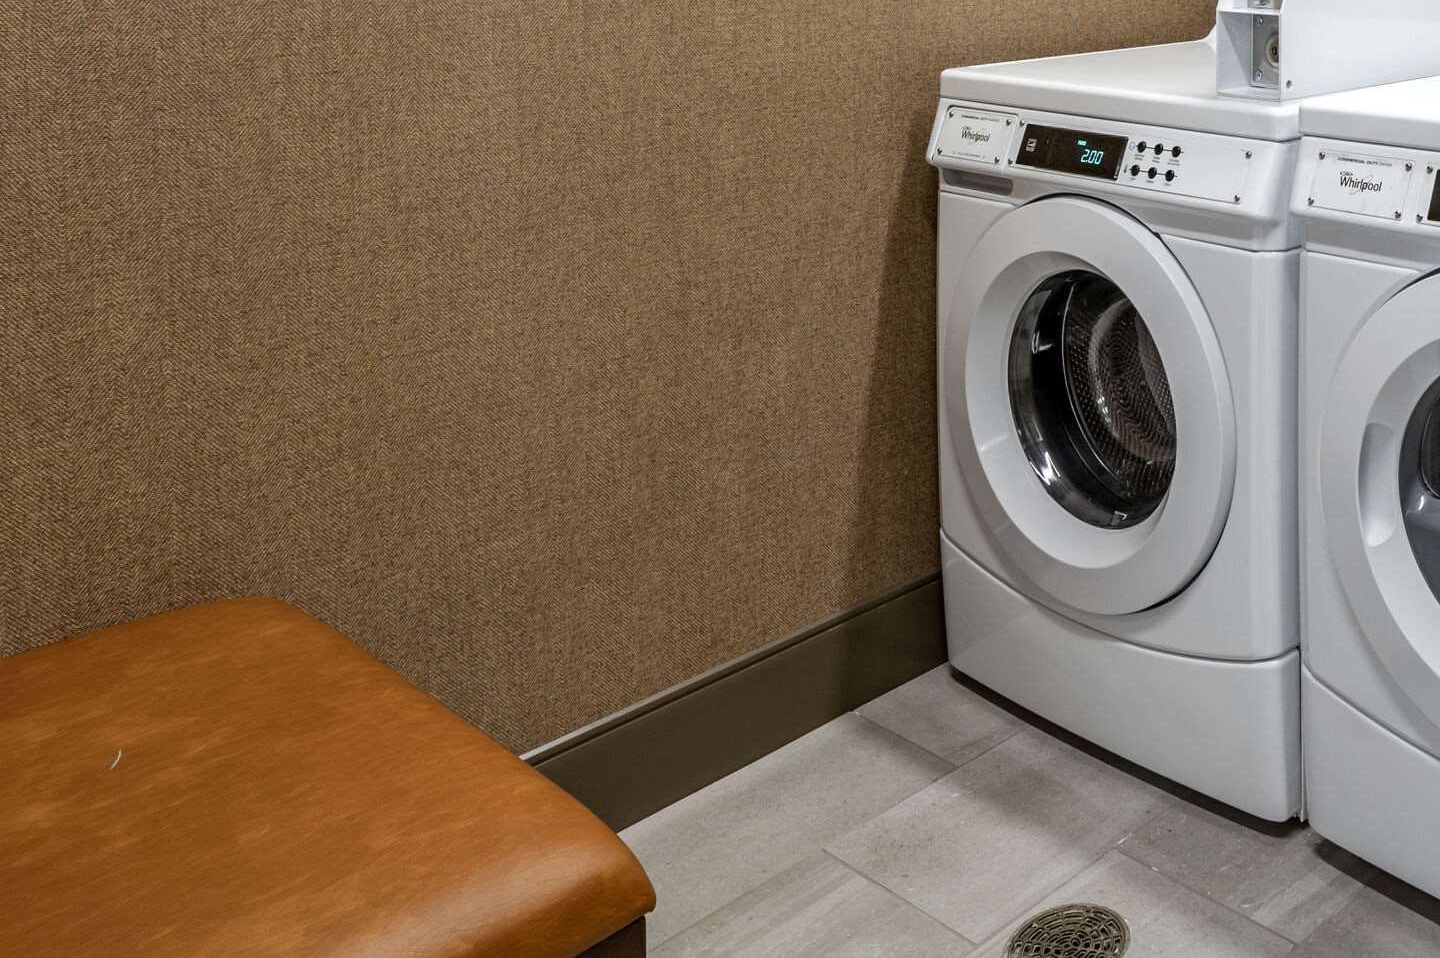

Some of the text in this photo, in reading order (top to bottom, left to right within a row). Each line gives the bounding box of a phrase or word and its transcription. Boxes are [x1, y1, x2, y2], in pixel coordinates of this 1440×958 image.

[961, 130, 991, 143] Whirlpool
[1080, 148, 1104, 165] 2.00
[1339, 175, 1383, 193] Whirlpool
